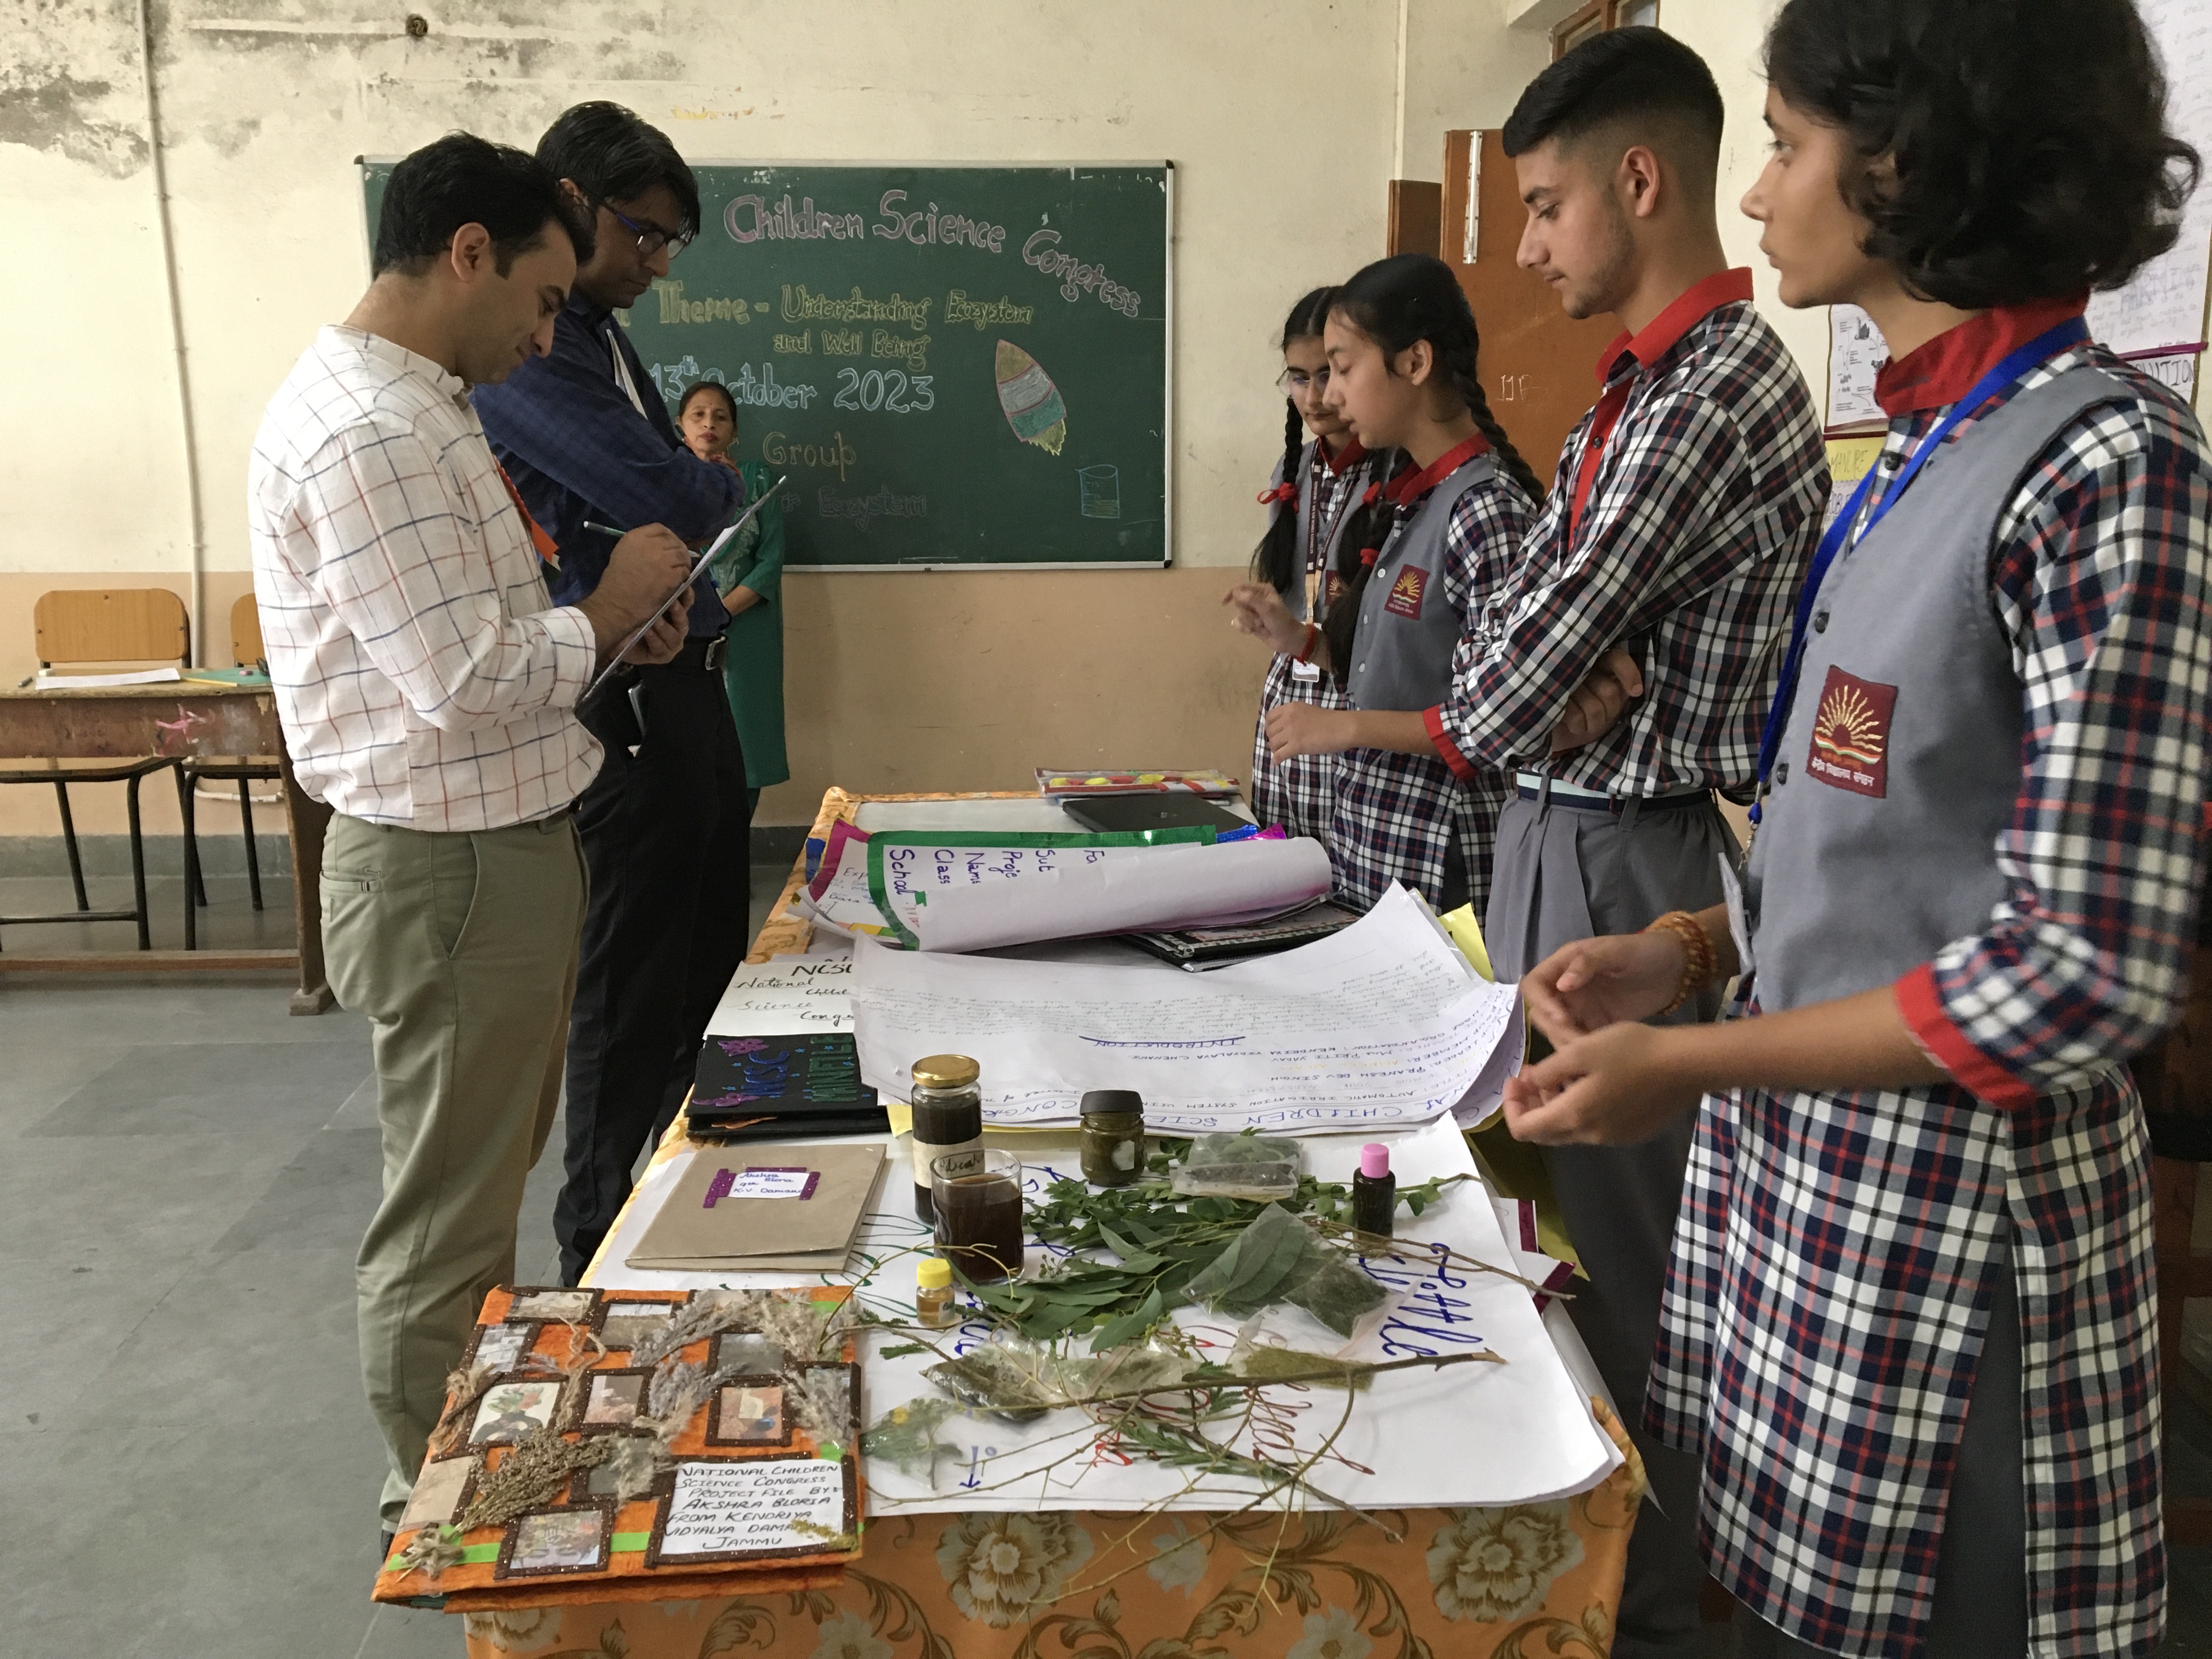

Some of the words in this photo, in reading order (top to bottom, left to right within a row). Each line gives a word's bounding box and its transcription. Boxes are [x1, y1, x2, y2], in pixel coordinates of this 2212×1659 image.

[724, 193, 864, 243] Children
[872, 189, 1006, 253] Science
[1023, 229, 1141, 318] Congress
[780, 284, 933, 330] Understanding
[944, 289, 1034, 329] Ecosystem
[772, 329, 812, 355] and
[871, 328, 932, 372] Being
[833, 367, 934, 413] 2023
[762, 431, 856, 482] Group
[889, 849, 916, 895] School
[935, 849, 955, 884] Class
[1094, 1040, 1242, 1049] INTRODUCTION
[1344, 1089, 1417, 1101] AUTOMATIC
[1241, 1108, 1402, 1126] CHILDREN
[681, 1466, 768, 1477] NATIONAL
[771, 1465, 838, 1476] CHILDREN
[675, 1478, 743, 1489] SCIENCE
[753, 1476, 826, 1487] CONGRESS
[688, 1488, 755, 1498] PROJECT
[761, 1488, 794, 1497] FILE
[682, 1499, 763, 1510] AKSHRA
[772, 1497, 831, 1508] BLORIA
[667, 1511, 716, 1525] FROM
[725, 1511, 812, 1522] KENDRIYA
[664, 1525, 735, 1537] VIDYALYA
[748, 1522, 806, 1533] DAMA
[703, 1537, 782, 1549] JAMMU
